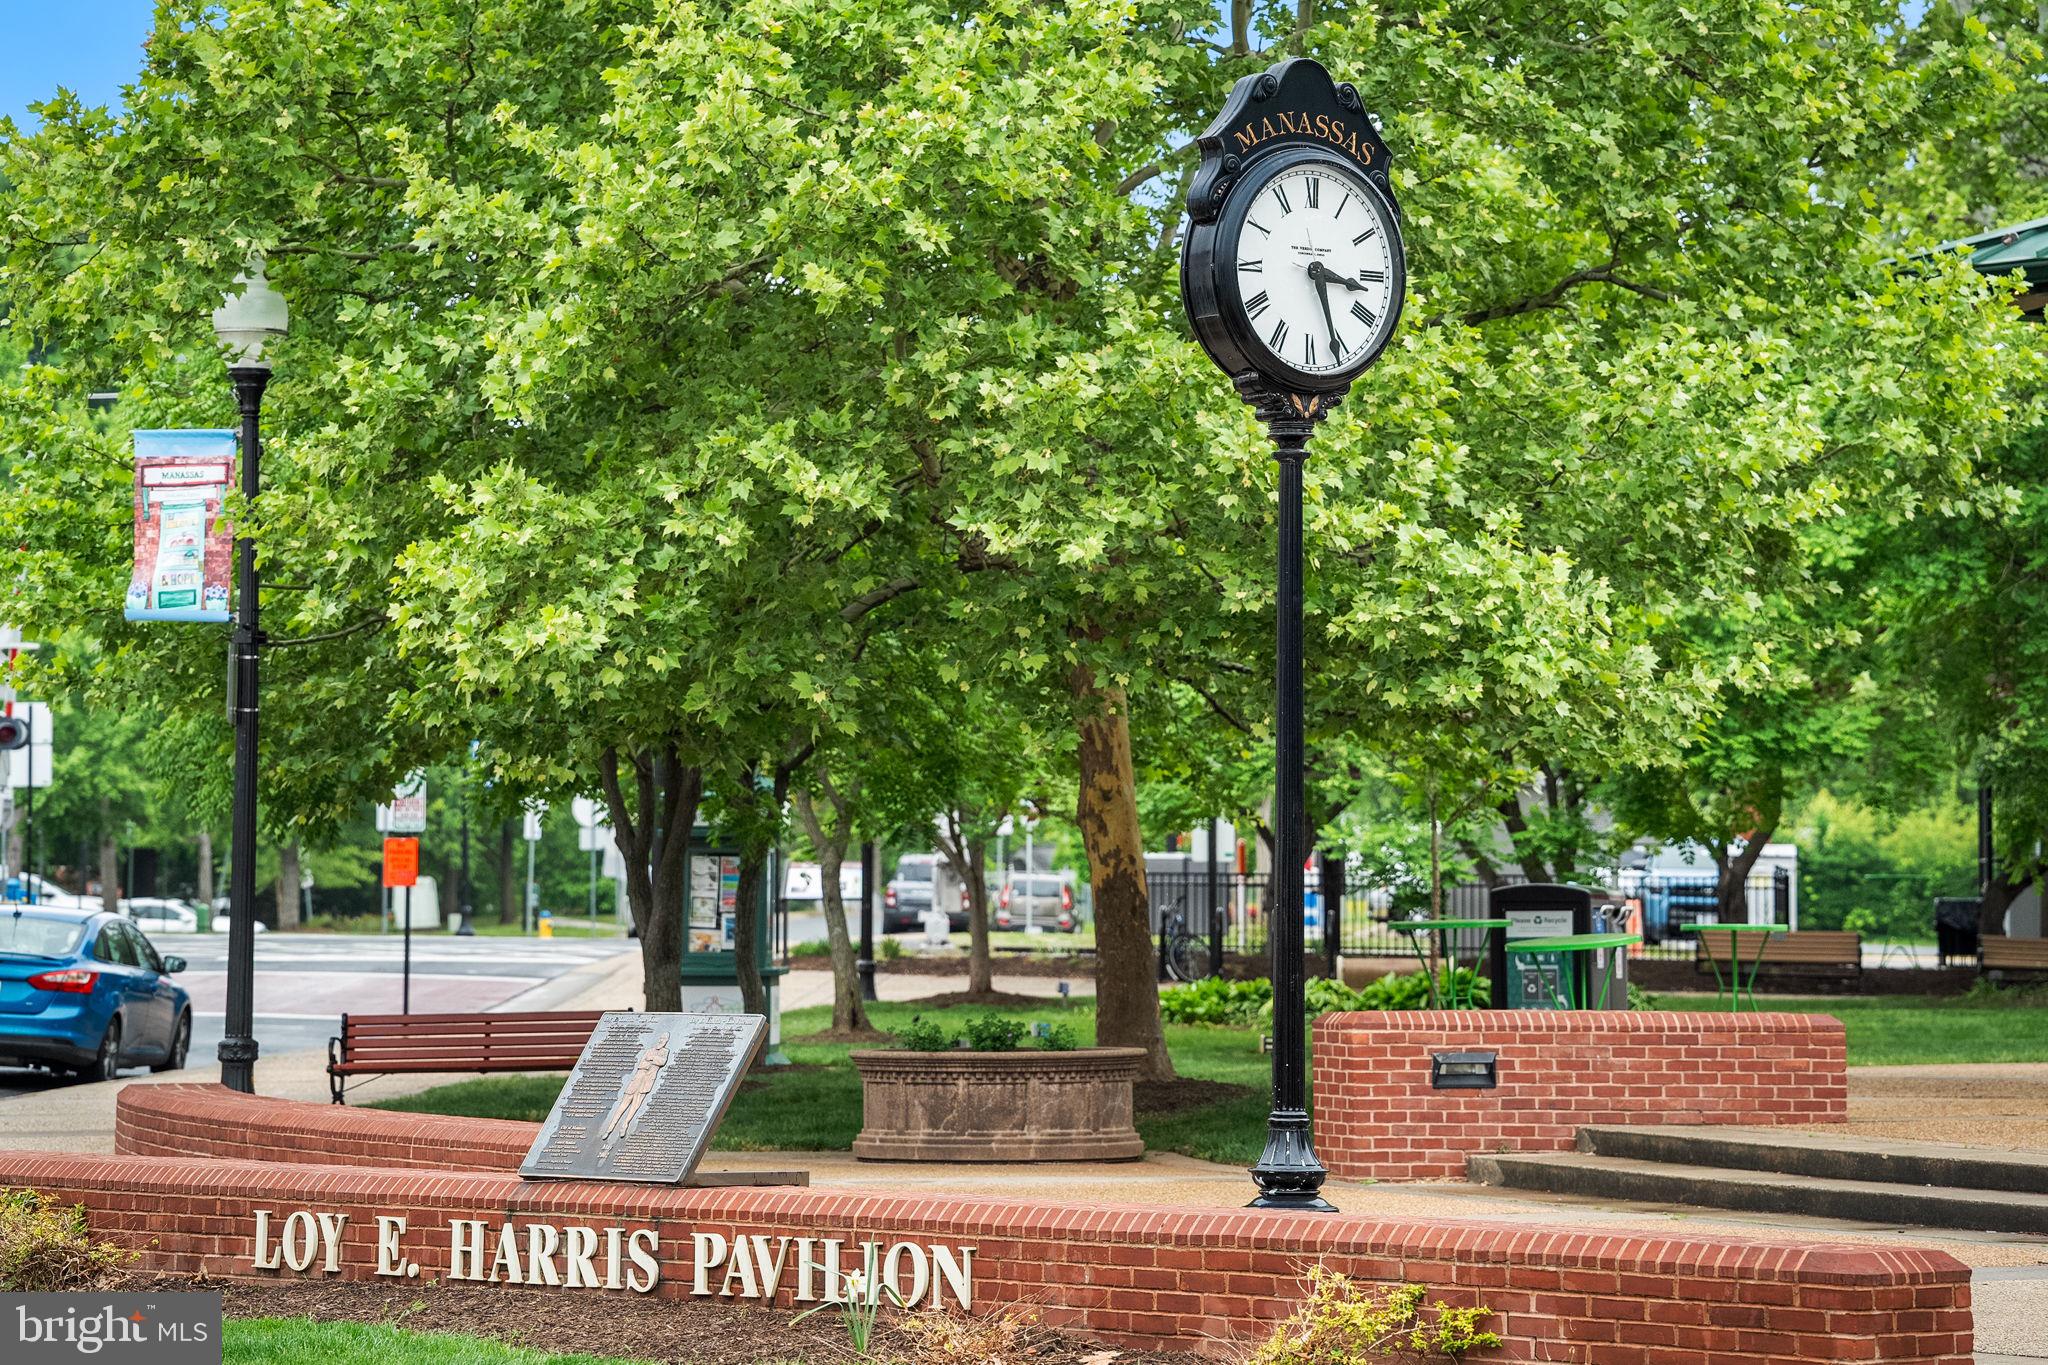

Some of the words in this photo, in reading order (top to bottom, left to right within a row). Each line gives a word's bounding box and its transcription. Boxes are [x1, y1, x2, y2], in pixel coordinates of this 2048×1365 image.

[1234, 111, 1375, 165] MANASSAS
[161, 471, 205, 480] MANASSAS
[251, 1209, 350, 1272] LOY
[374, 1215, 420, 1279] E.
[447, 1219, 660, 1293] HARRIS
[689, 1232, 978, 1312] PAVILION
